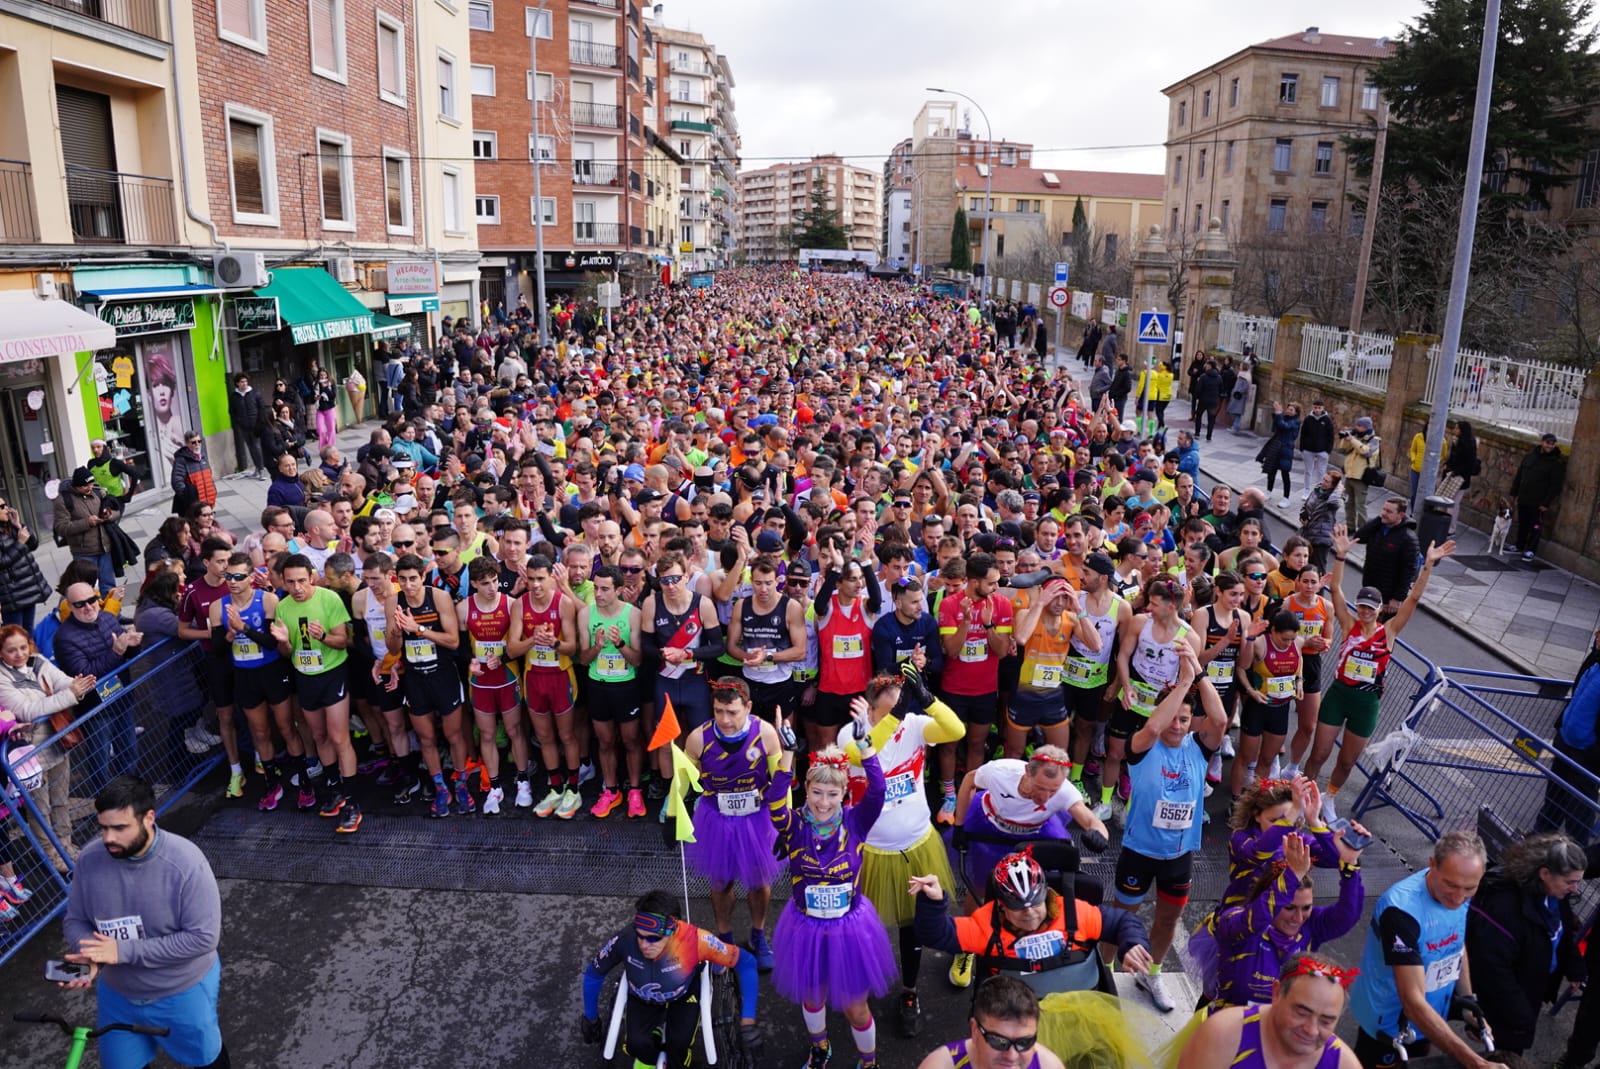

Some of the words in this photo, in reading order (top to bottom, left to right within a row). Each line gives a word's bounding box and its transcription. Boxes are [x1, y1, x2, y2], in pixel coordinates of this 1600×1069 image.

[6, 335, 86, 360] CONSENTIDA
[1303, 625, 1314, 634] 49
[240, 644, 250, 653] 40
[414, 646, 422, 655] 12
[843, 642, 850, 651] 3
[299, 655, 312, 665] 138
[608, 660, 614, 669] 5
[1218, 668, 1224, 677] 6
[1355, 665, 1361, 674] 4
[1042, 670, 1054, 680] 23
[1279, 682, 1284, 691] 8
[884, 782, 908, 800] 342
[727, 799, 747, 809] 307
[1160, 808, 1188, 820] 6562
[813, 894, 841, 907] 3915
[1025, 941, 1055, 960] 4081
